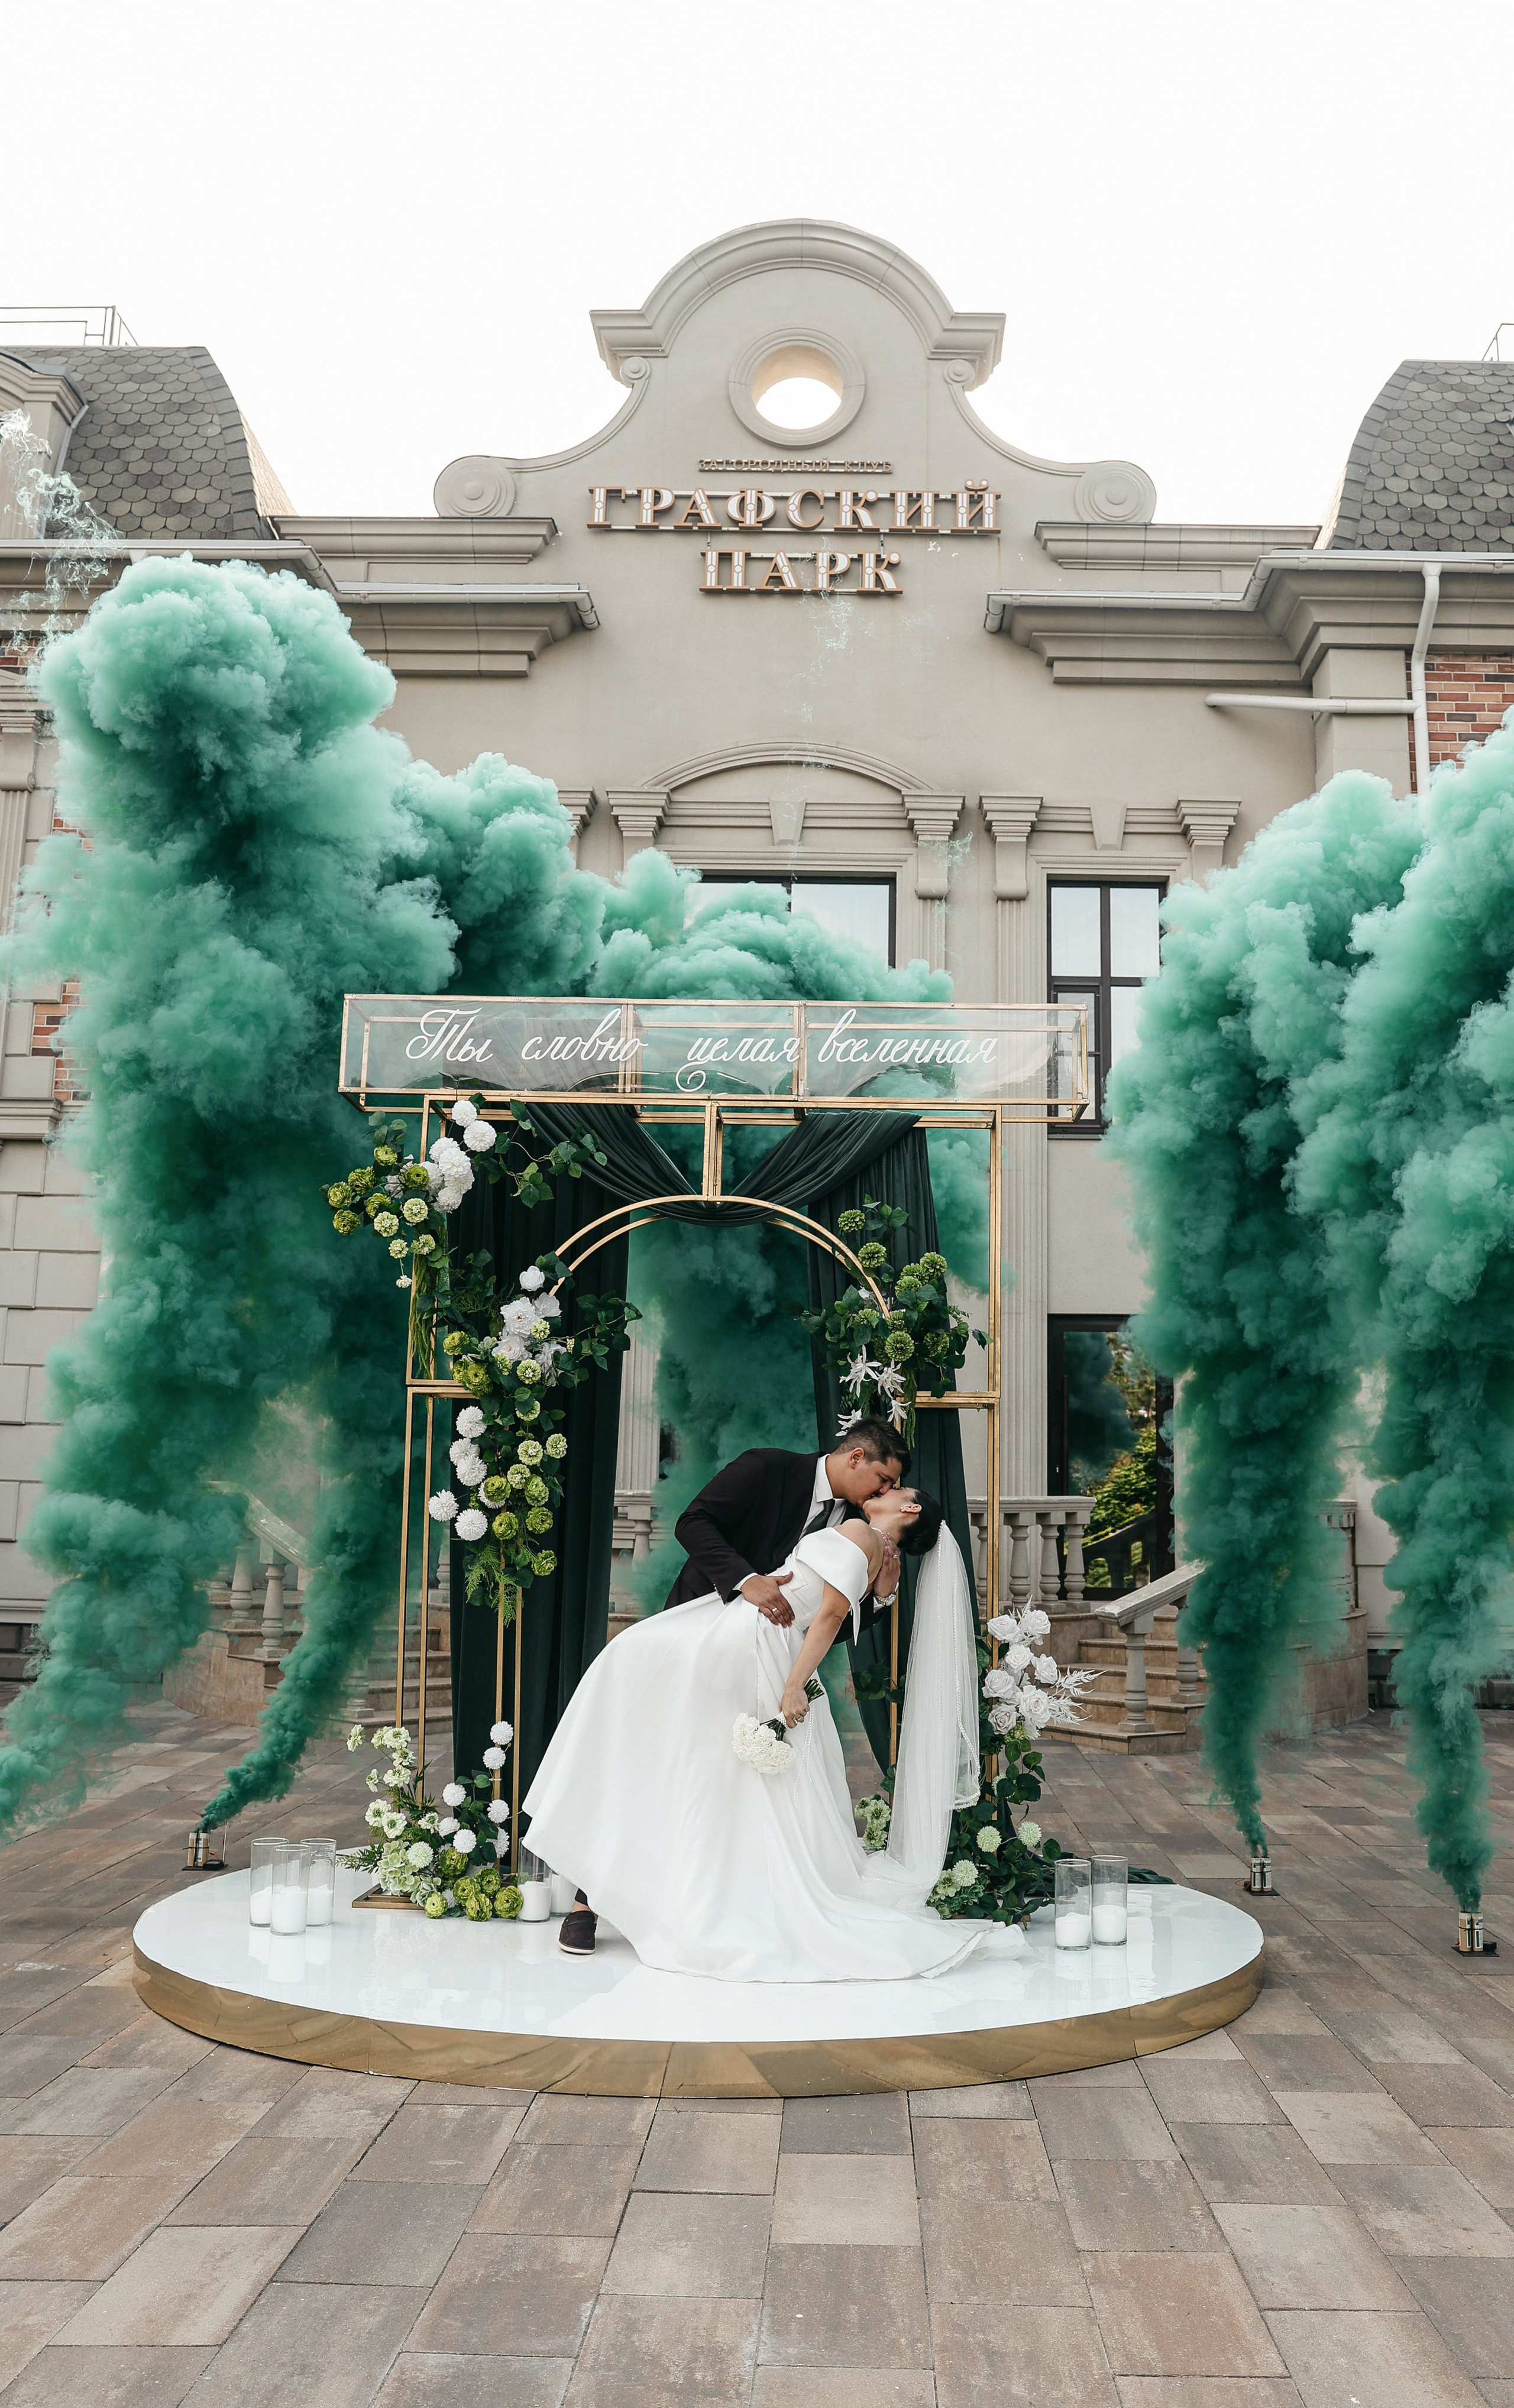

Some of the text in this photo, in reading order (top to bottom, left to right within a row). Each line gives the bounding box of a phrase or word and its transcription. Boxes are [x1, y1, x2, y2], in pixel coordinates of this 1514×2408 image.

[698, 458, 891, 472] ЗАГОРОДНЫЙ КЛУБ
[587, 478, 1001, 534] ГРАФСКИЙ
[699, 549, 902, 594] ПАРК
[406, 1007, 997, 1092] Ты словно целая вселенная
